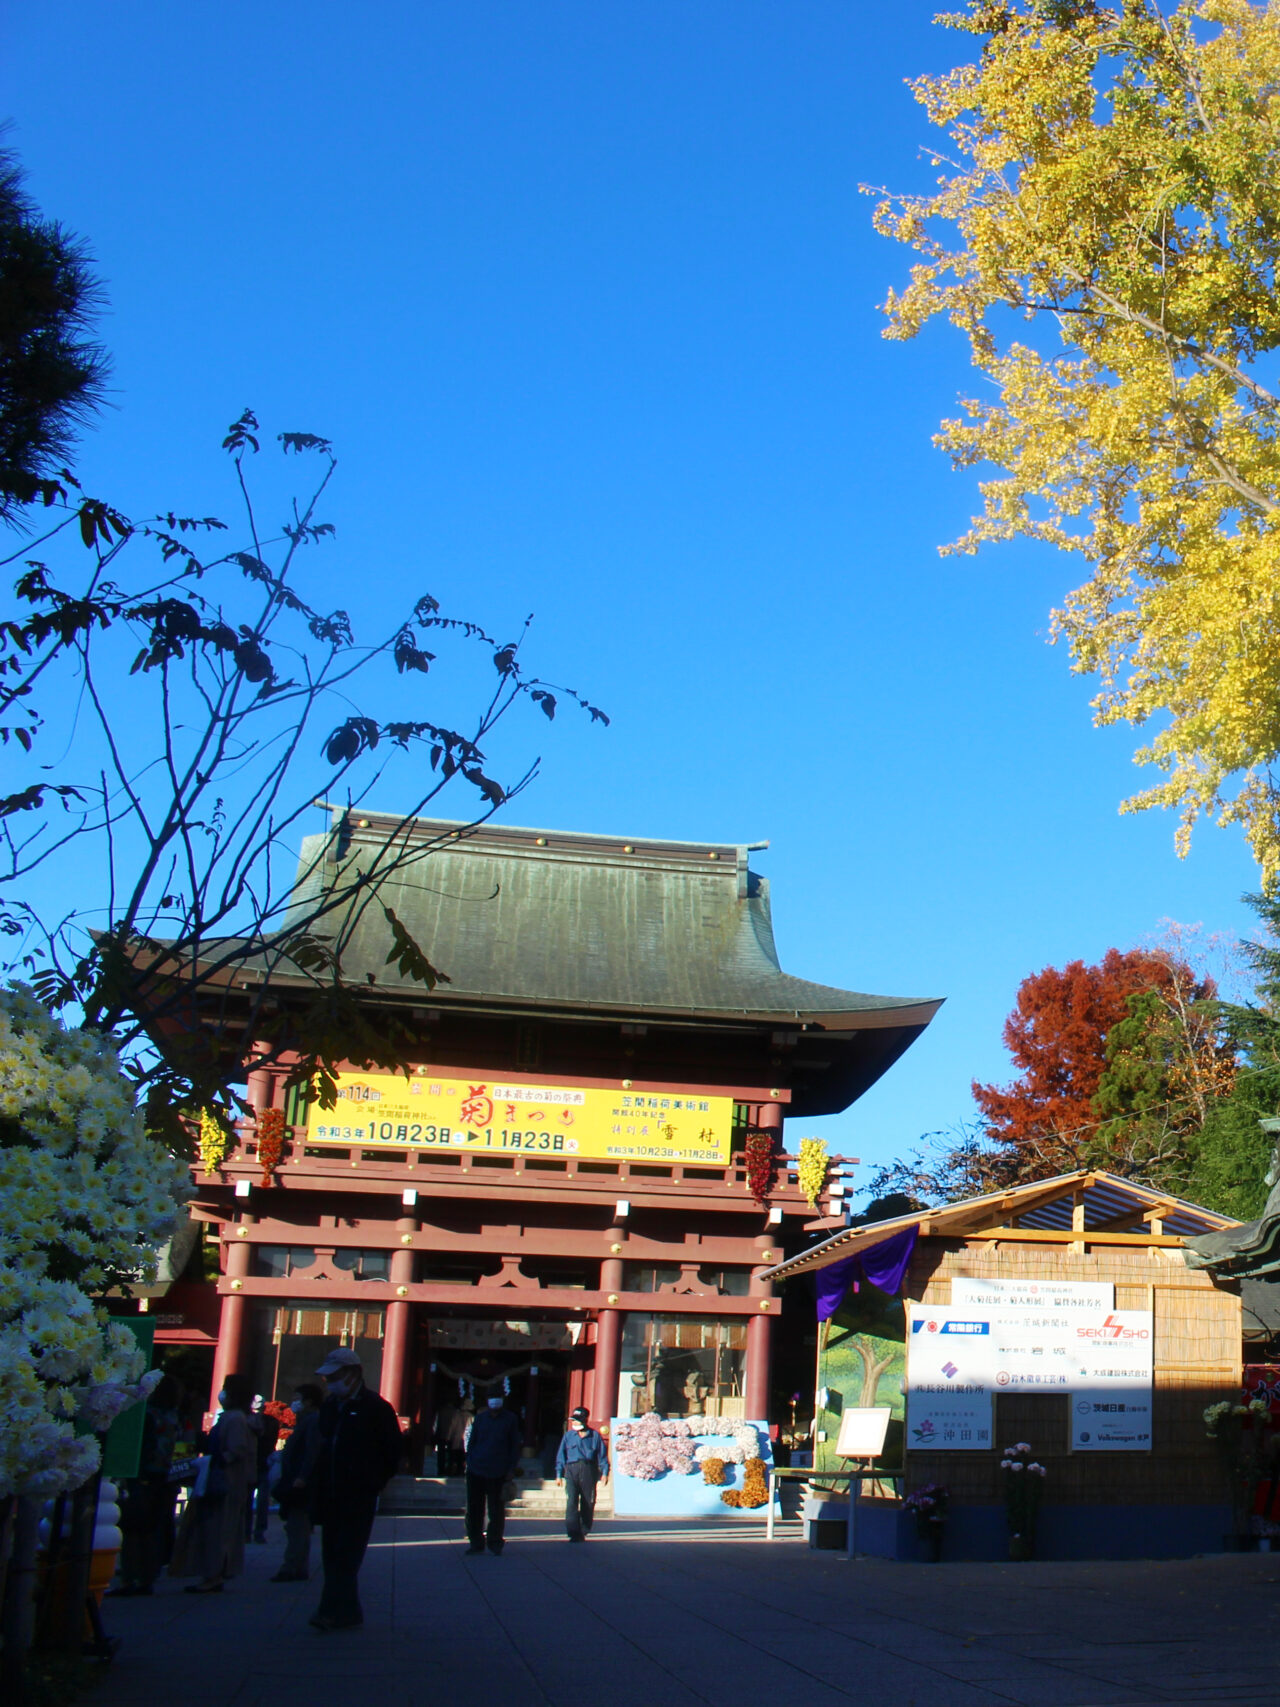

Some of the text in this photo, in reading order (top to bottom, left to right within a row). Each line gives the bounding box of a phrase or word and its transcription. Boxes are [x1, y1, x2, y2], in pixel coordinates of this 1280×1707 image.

[622, 1096, 709, 1112] 笠間稲荷美術館
